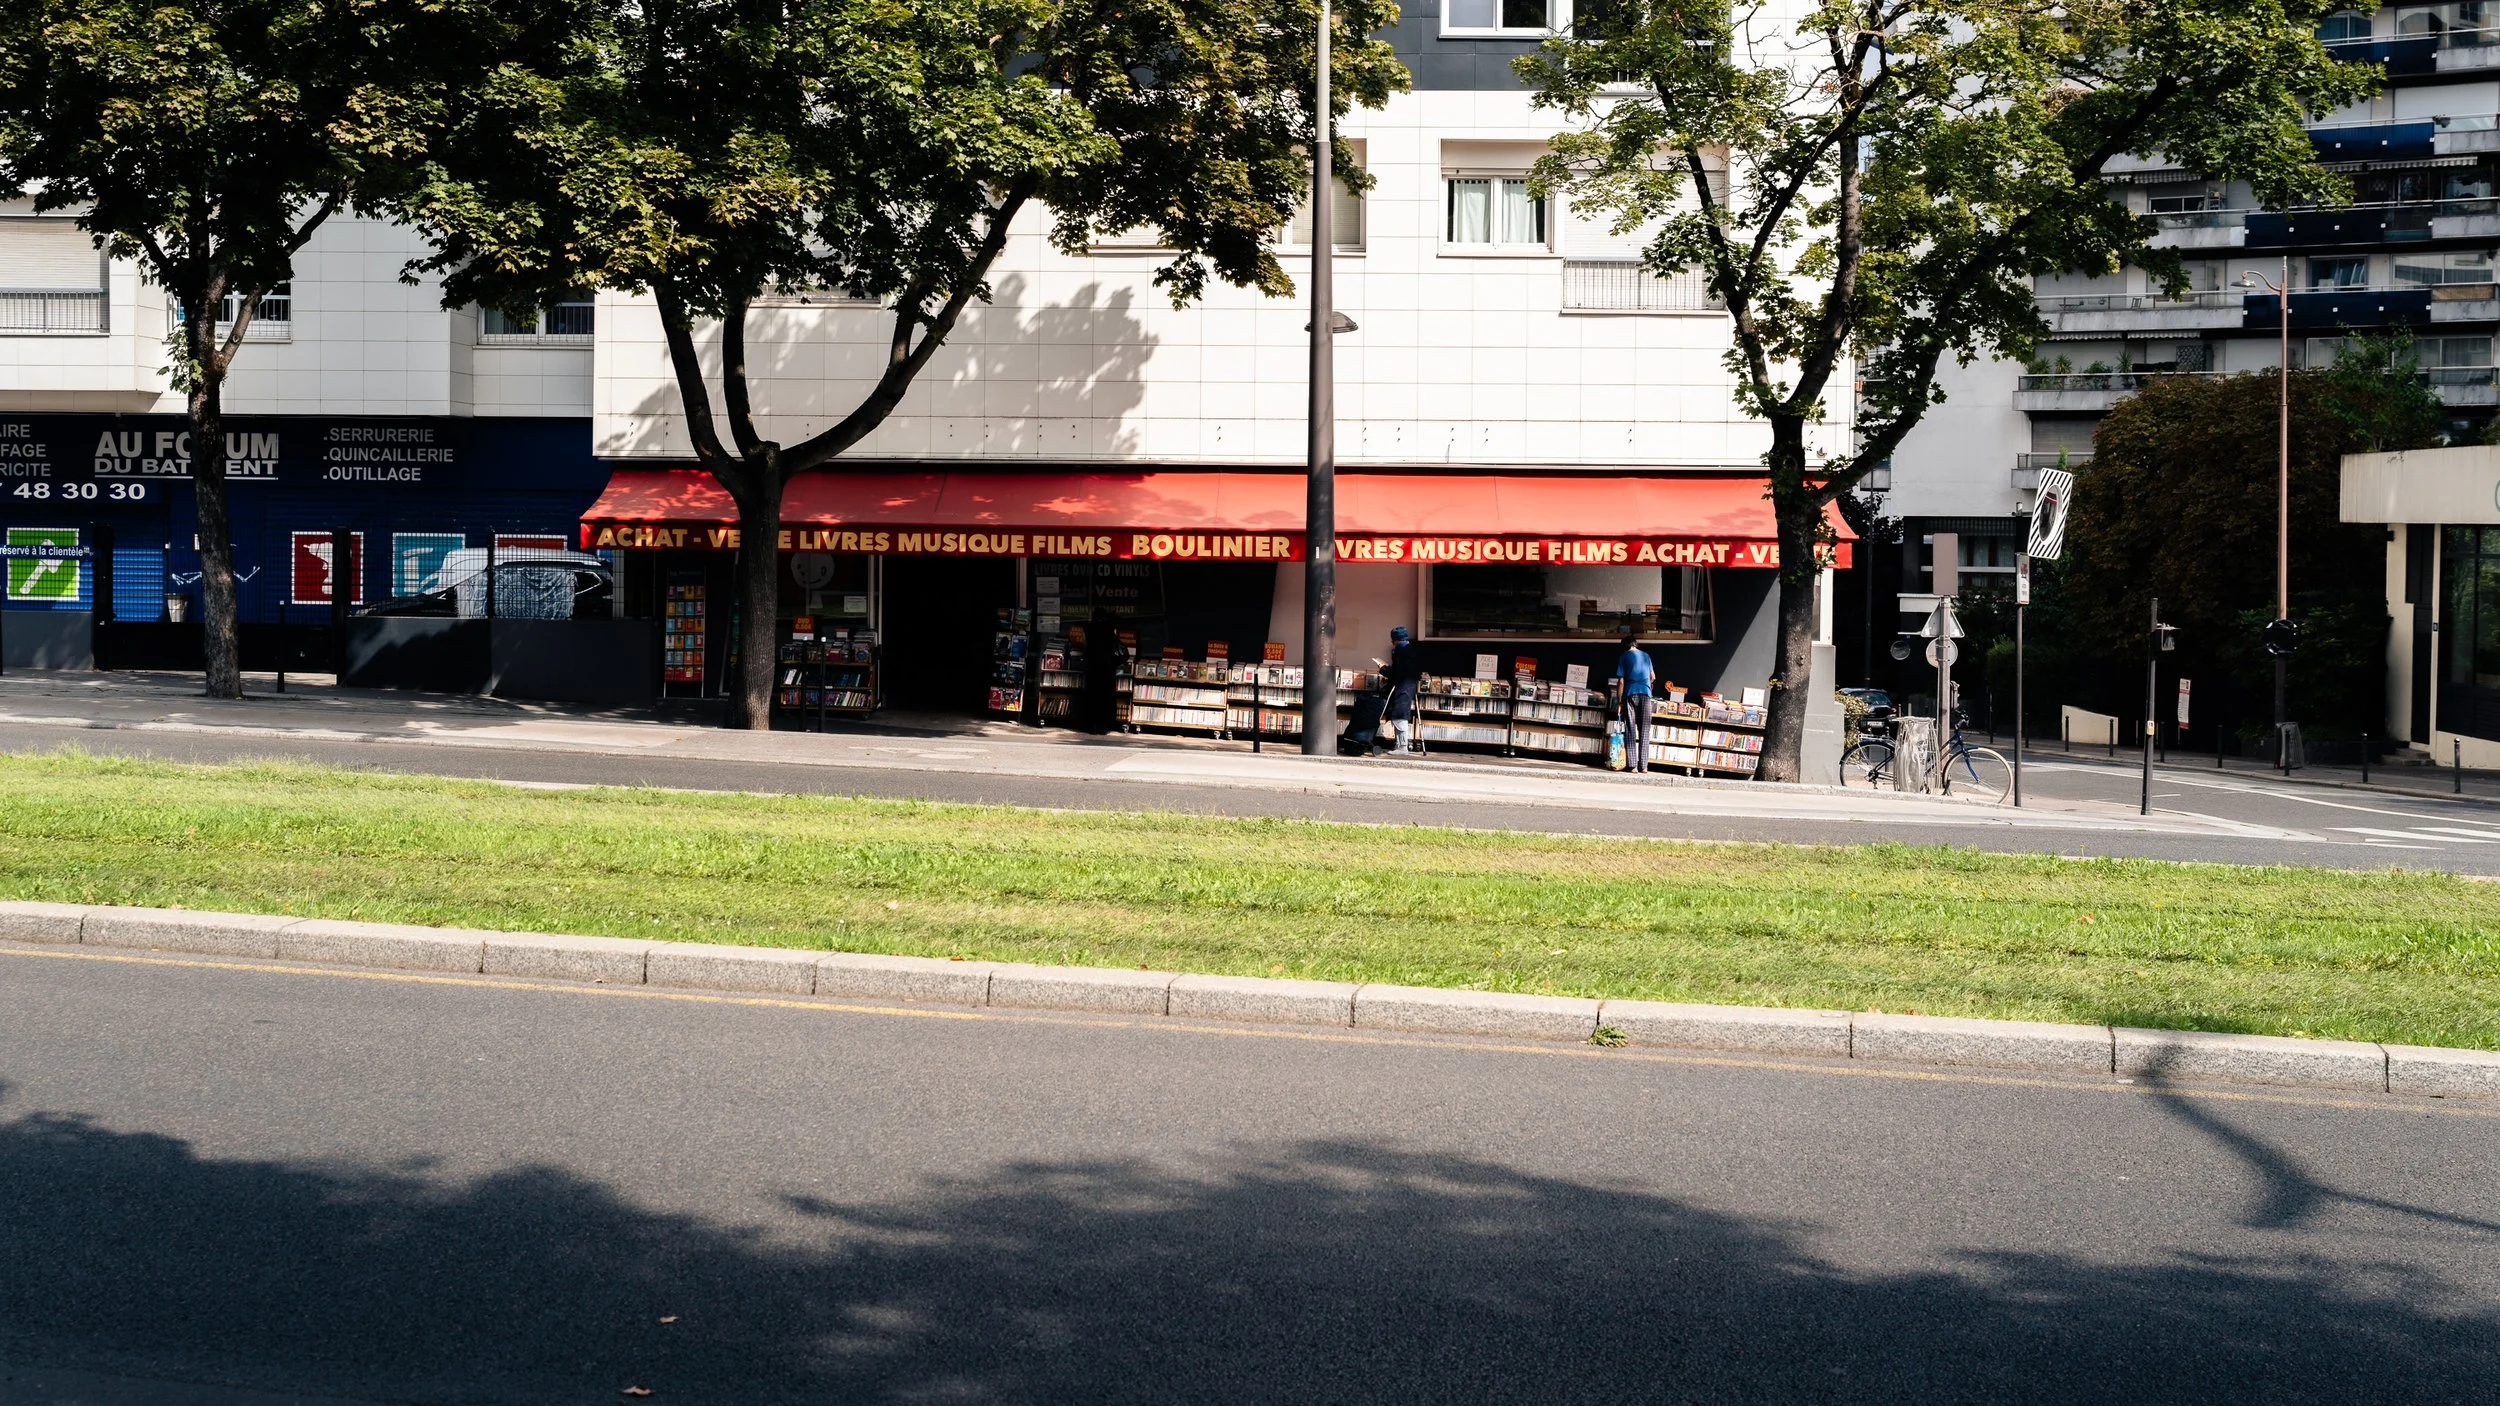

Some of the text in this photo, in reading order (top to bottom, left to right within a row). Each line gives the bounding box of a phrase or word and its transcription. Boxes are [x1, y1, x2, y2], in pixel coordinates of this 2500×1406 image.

[0, 424, 31, 437] IRE
[95, 432, 279, 459] AU FOUM
[94, 458, 278, 475] DU BATENT
[13, 482, 146, 500] 48 30 30
[31, 545, 37, 555] à
[39, 546, 46, 555] la
[48, 546, 83, 556] clientèle
[596, 527, 688, 548] ACHAT
[707, 529, 792, 549] VEE
[800, 530, 890, 551] LIVRES
[898, 533, 1025, 554] MUSIQUE
[1032, 535, 1112, 556] FILMS
[1132, 534, 1291, 558] BOULINIER
[1411, 540, 1540, 561] MUSIQUE
[1548, 541, 1628, 562] FILMS
[1636, 543, 1730, 563] ACHAT
[1097, 564, 1111, 577] CD
[1114, 564, 1151, 578] VINYLS
